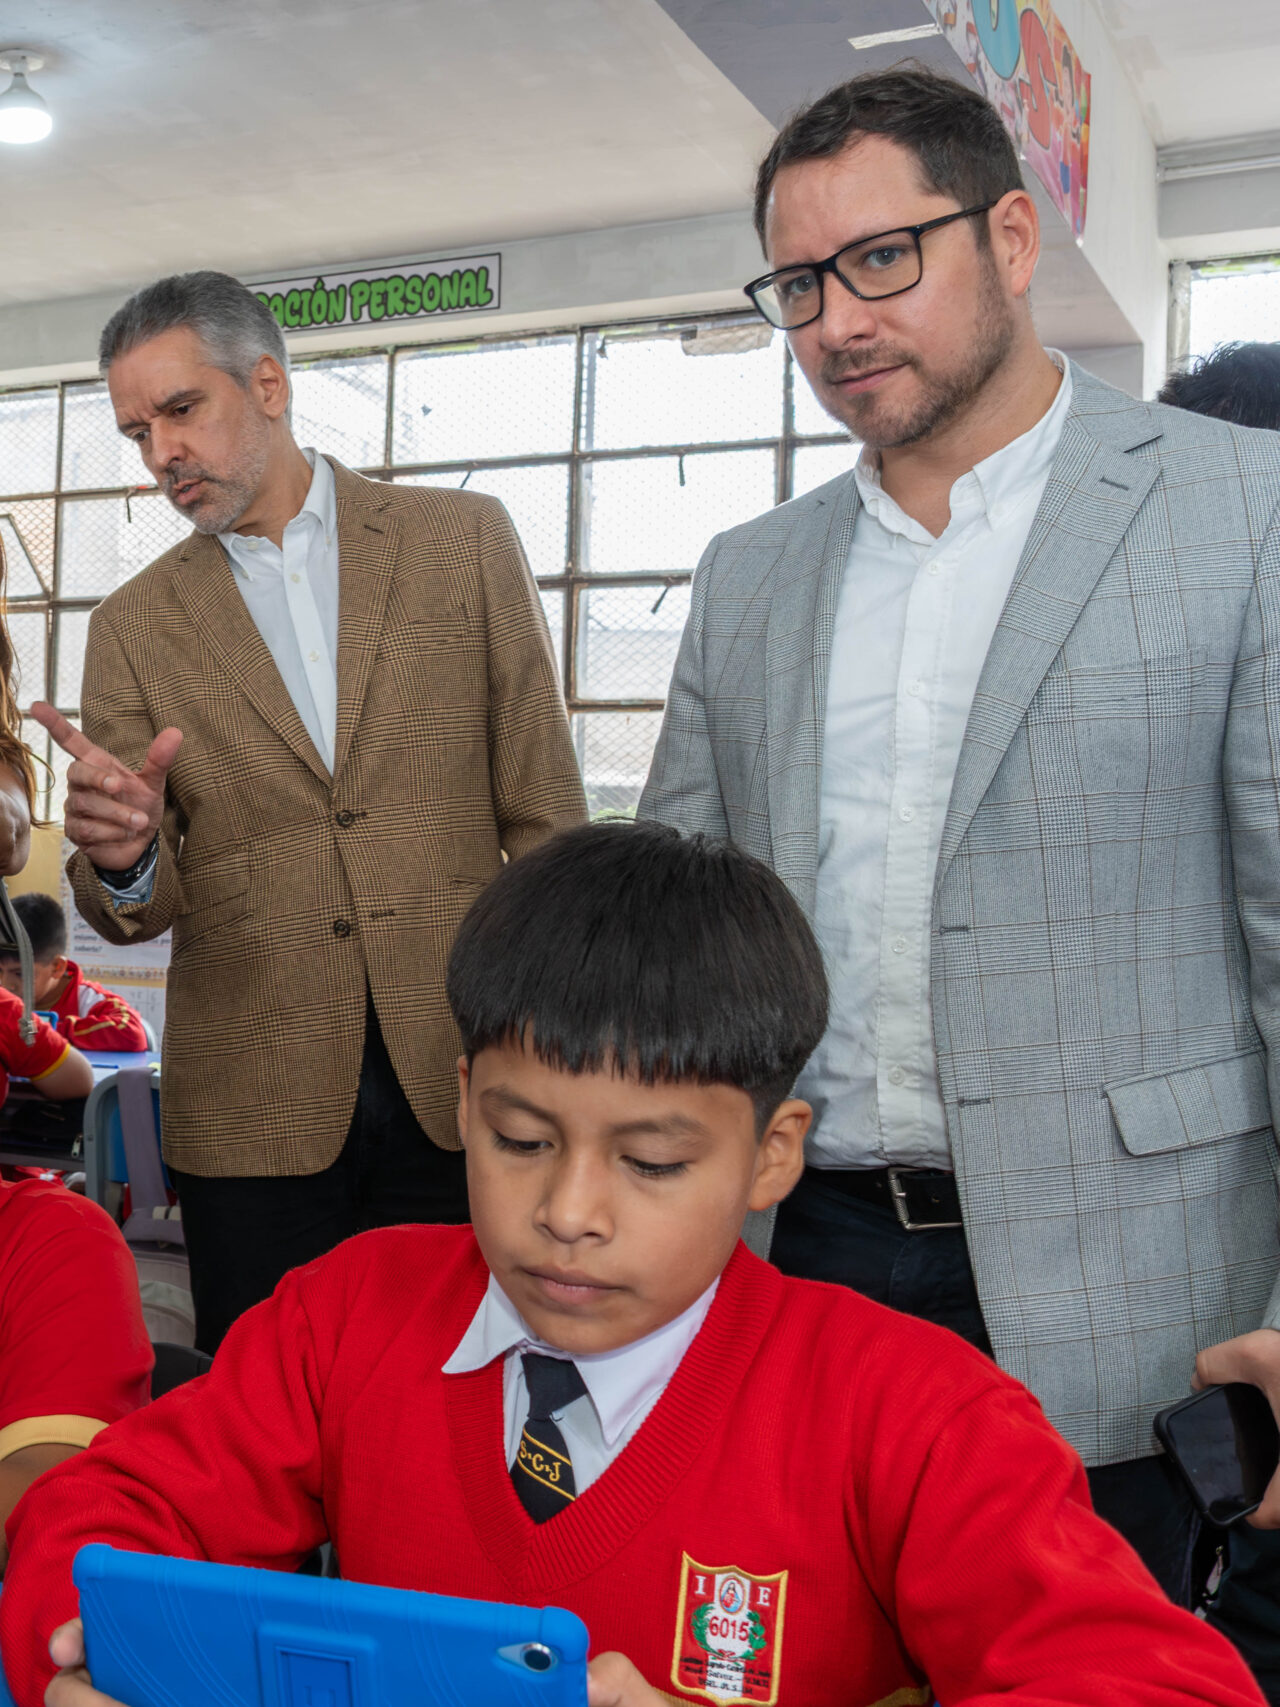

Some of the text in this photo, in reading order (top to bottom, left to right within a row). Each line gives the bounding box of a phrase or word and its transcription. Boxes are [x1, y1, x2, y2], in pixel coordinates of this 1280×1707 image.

[256, 265, 493, 328] ACIÓN PERSONAL
[694, 1575, 772, 1607] I E
[708, 1615, 750, 1642] 6015
